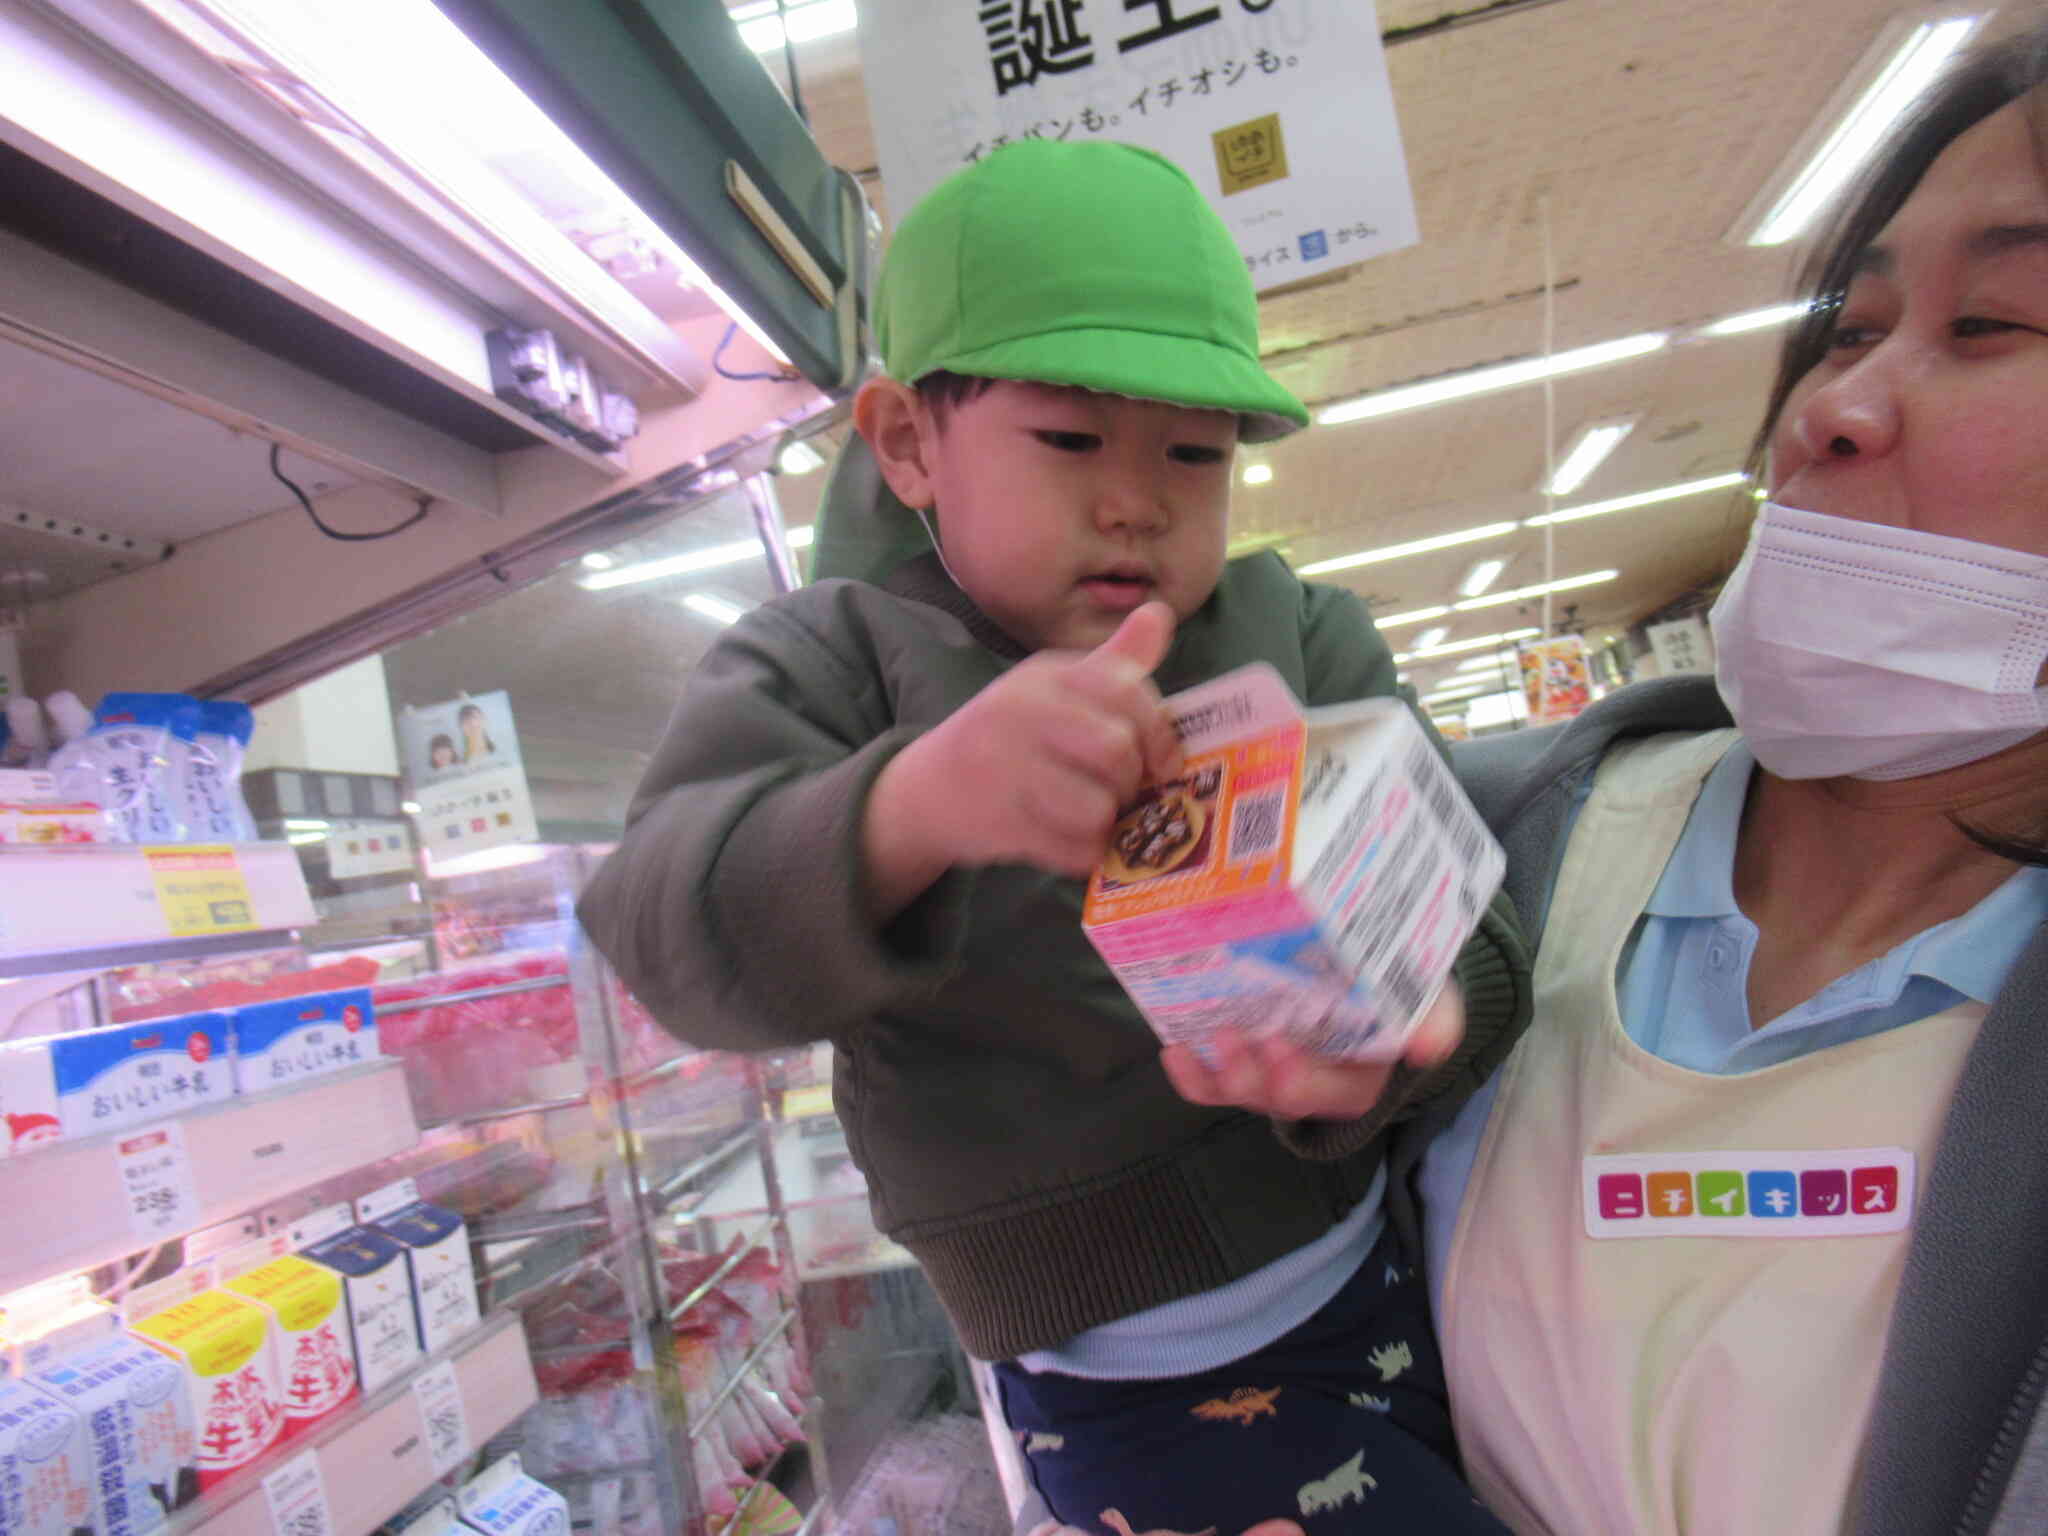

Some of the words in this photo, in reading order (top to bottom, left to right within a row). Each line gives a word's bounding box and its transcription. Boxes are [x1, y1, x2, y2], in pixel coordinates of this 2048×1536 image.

[1611, 1179, 1892, 1216] ニチイキッズ
